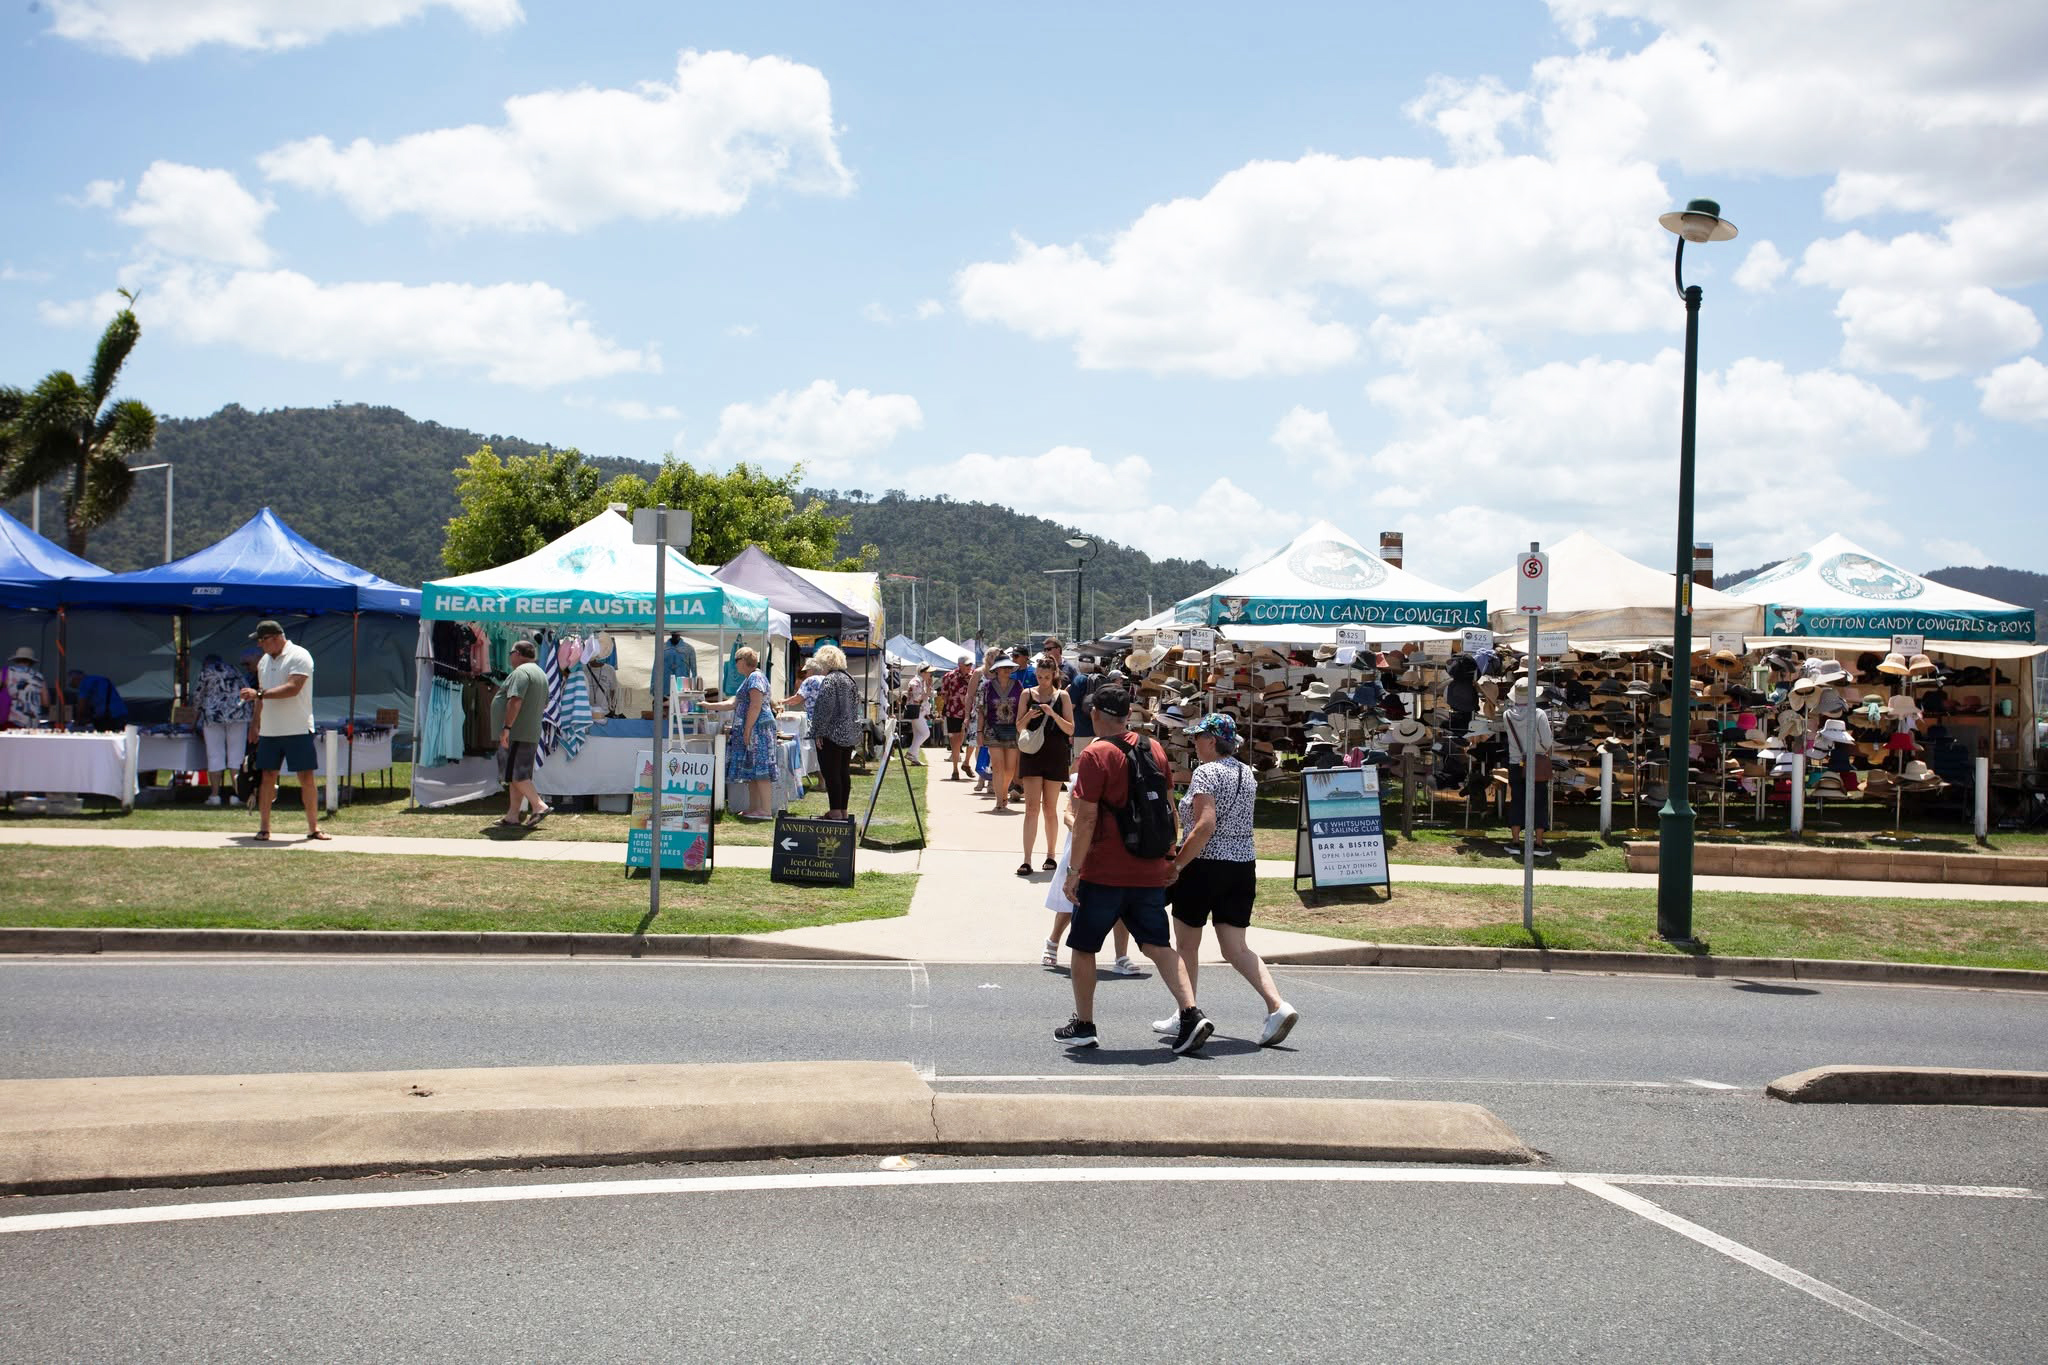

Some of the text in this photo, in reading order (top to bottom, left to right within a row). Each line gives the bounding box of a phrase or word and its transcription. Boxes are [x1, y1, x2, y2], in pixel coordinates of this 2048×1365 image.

[435, 595, 510, 613] HEART
[515, 597, 572, 615] REEF
[1255, 604, 1481, 626] COTTON CANDY COWGIRLS
[1810, 616, 1866, 630] COTTON
[1868, 616, 1914, 631] CANDY
[1917, 618, 1985, 633] COWGIRLS
[2000, 620, 2032, 634] BOYS
[779, 823, 850, 836] ANNIE'S COFFEE
[1330, 819, 1380, 828] WHITSUNDAY
[1331, 826, 1359, 834] SAILING
[1361, 825, 1380, 833] CLUB
[634, 833, 673, 841] SMOOIES
[790, 858, 834, 869] Iced Coffee
[783, 866, 840, 879] Iced Chocolate
